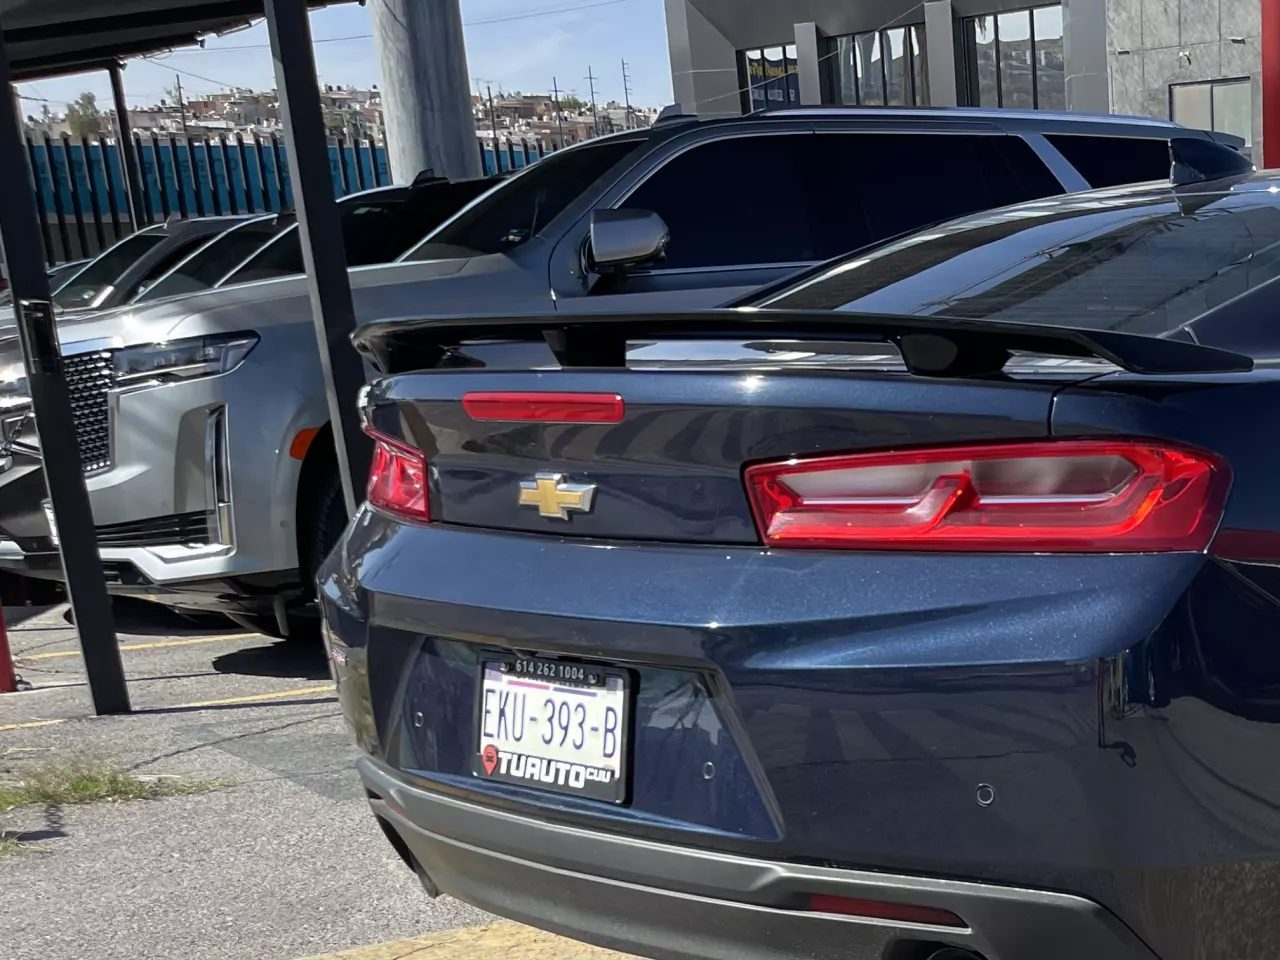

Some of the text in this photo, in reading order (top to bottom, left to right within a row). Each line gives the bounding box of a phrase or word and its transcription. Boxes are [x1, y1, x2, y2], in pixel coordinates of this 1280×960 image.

[515, 659, 584, 681] 614 262 1004
[483, 688, 618, 759] EKU-393-B
